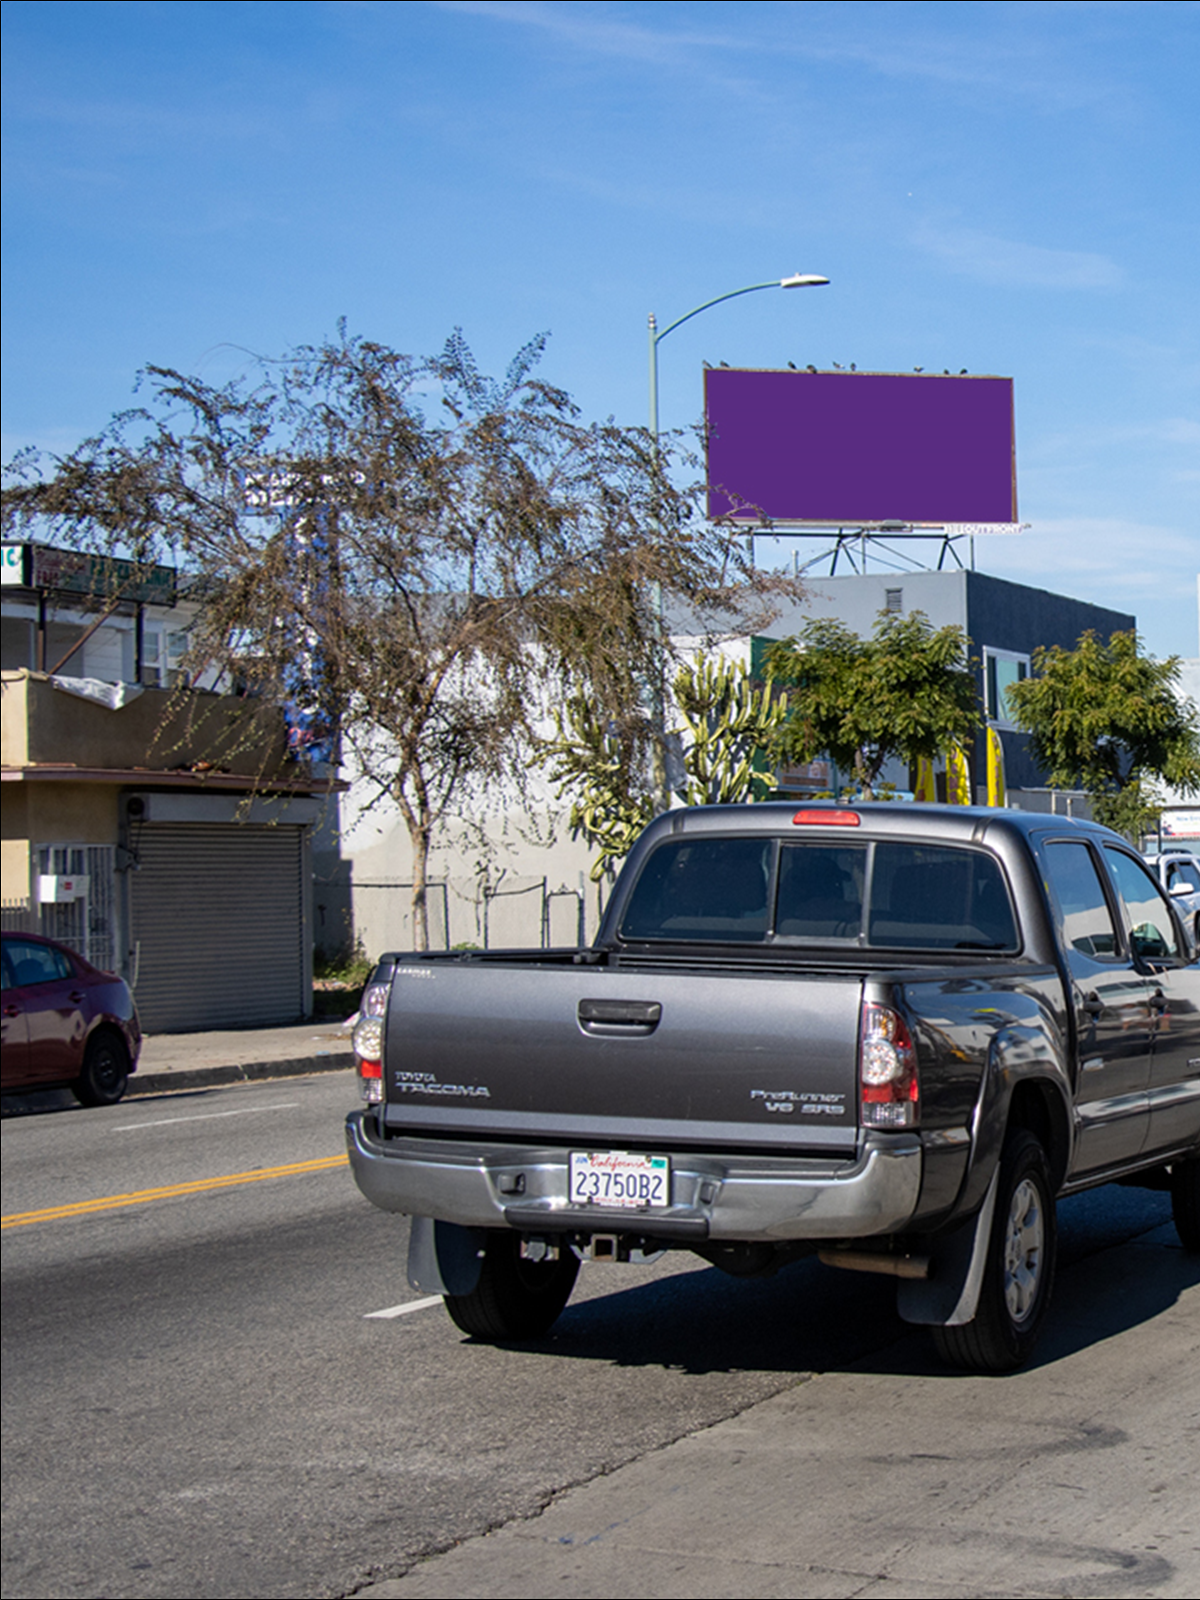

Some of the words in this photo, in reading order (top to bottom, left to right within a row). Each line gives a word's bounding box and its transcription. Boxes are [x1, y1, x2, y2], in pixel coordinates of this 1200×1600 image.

[395, 1070, 436, 1082] TOYOTA
[395, 1082, 491, 1098] TACOMA
[750, 1089, 845, 1103] PreRunner
[765, 1101, 794, 1113] V6
[590, 1155, 652, 1171] California
[576, 1170, 663, 1200] 23750B2
